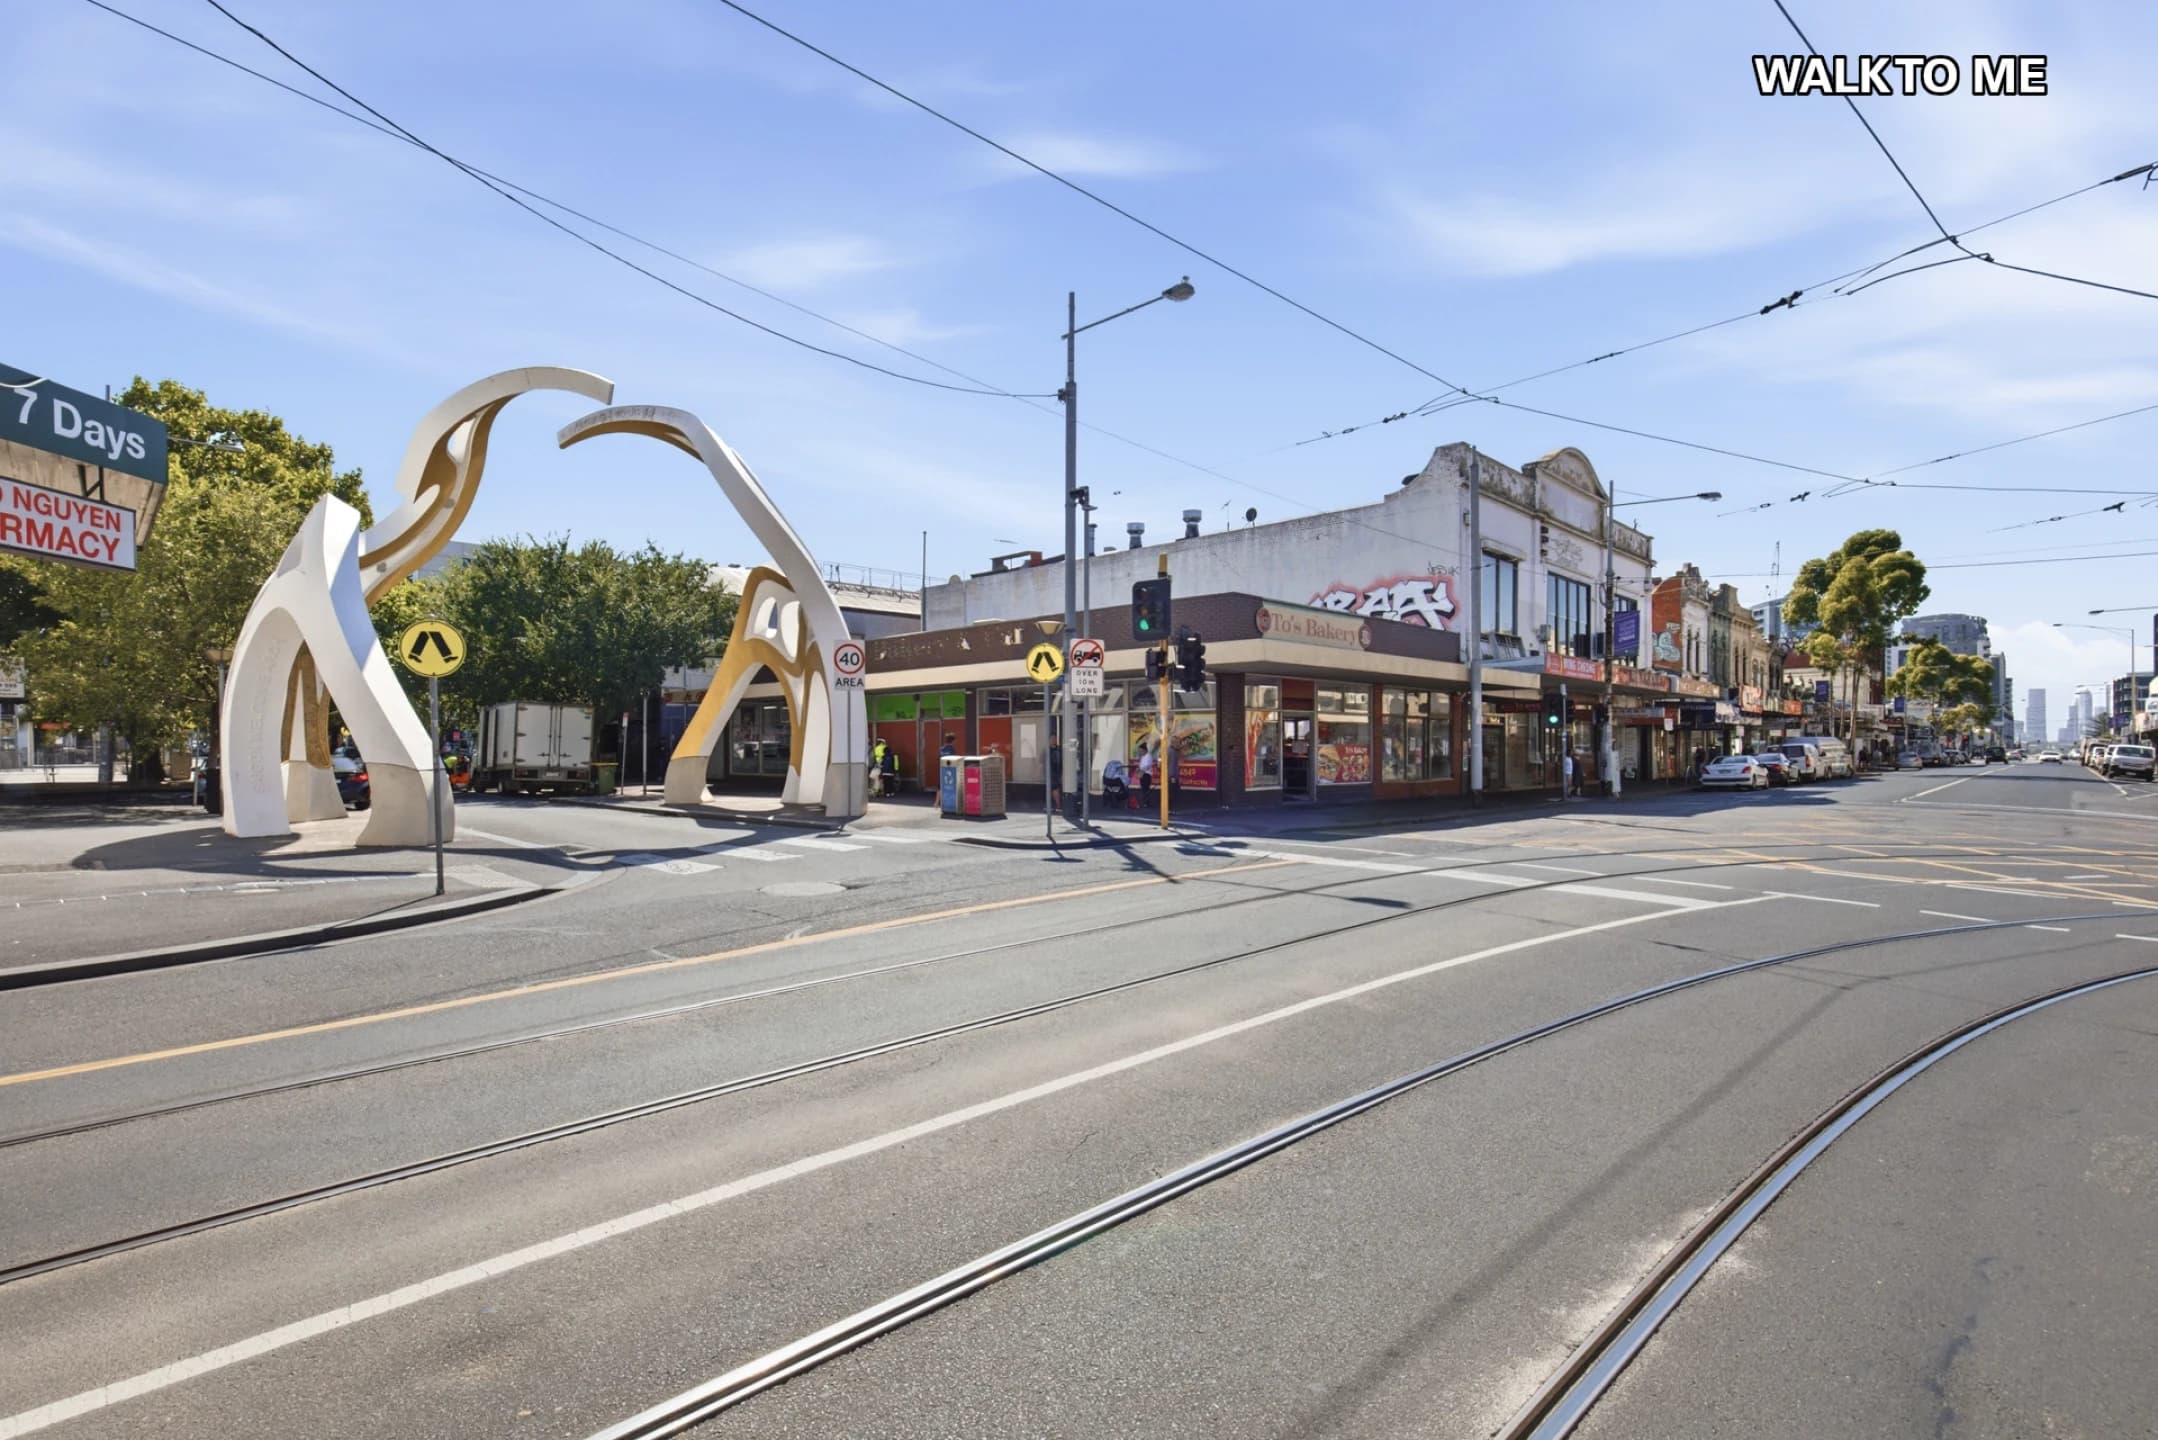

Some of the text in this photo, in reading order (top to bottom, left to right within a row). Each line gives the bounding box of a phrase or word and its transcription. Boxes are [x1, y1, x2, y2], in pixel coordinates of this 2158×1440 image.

[13, 387, 146, 461] 7 Days
[12, 486, 121, 533] NGUYEN
[0, 512, 120, 561] RMACY
[1272, 612, 1358, 647] To's Bakery
[839, 652, 860, 666] 40
[835, 677, 864, 687] AREA
